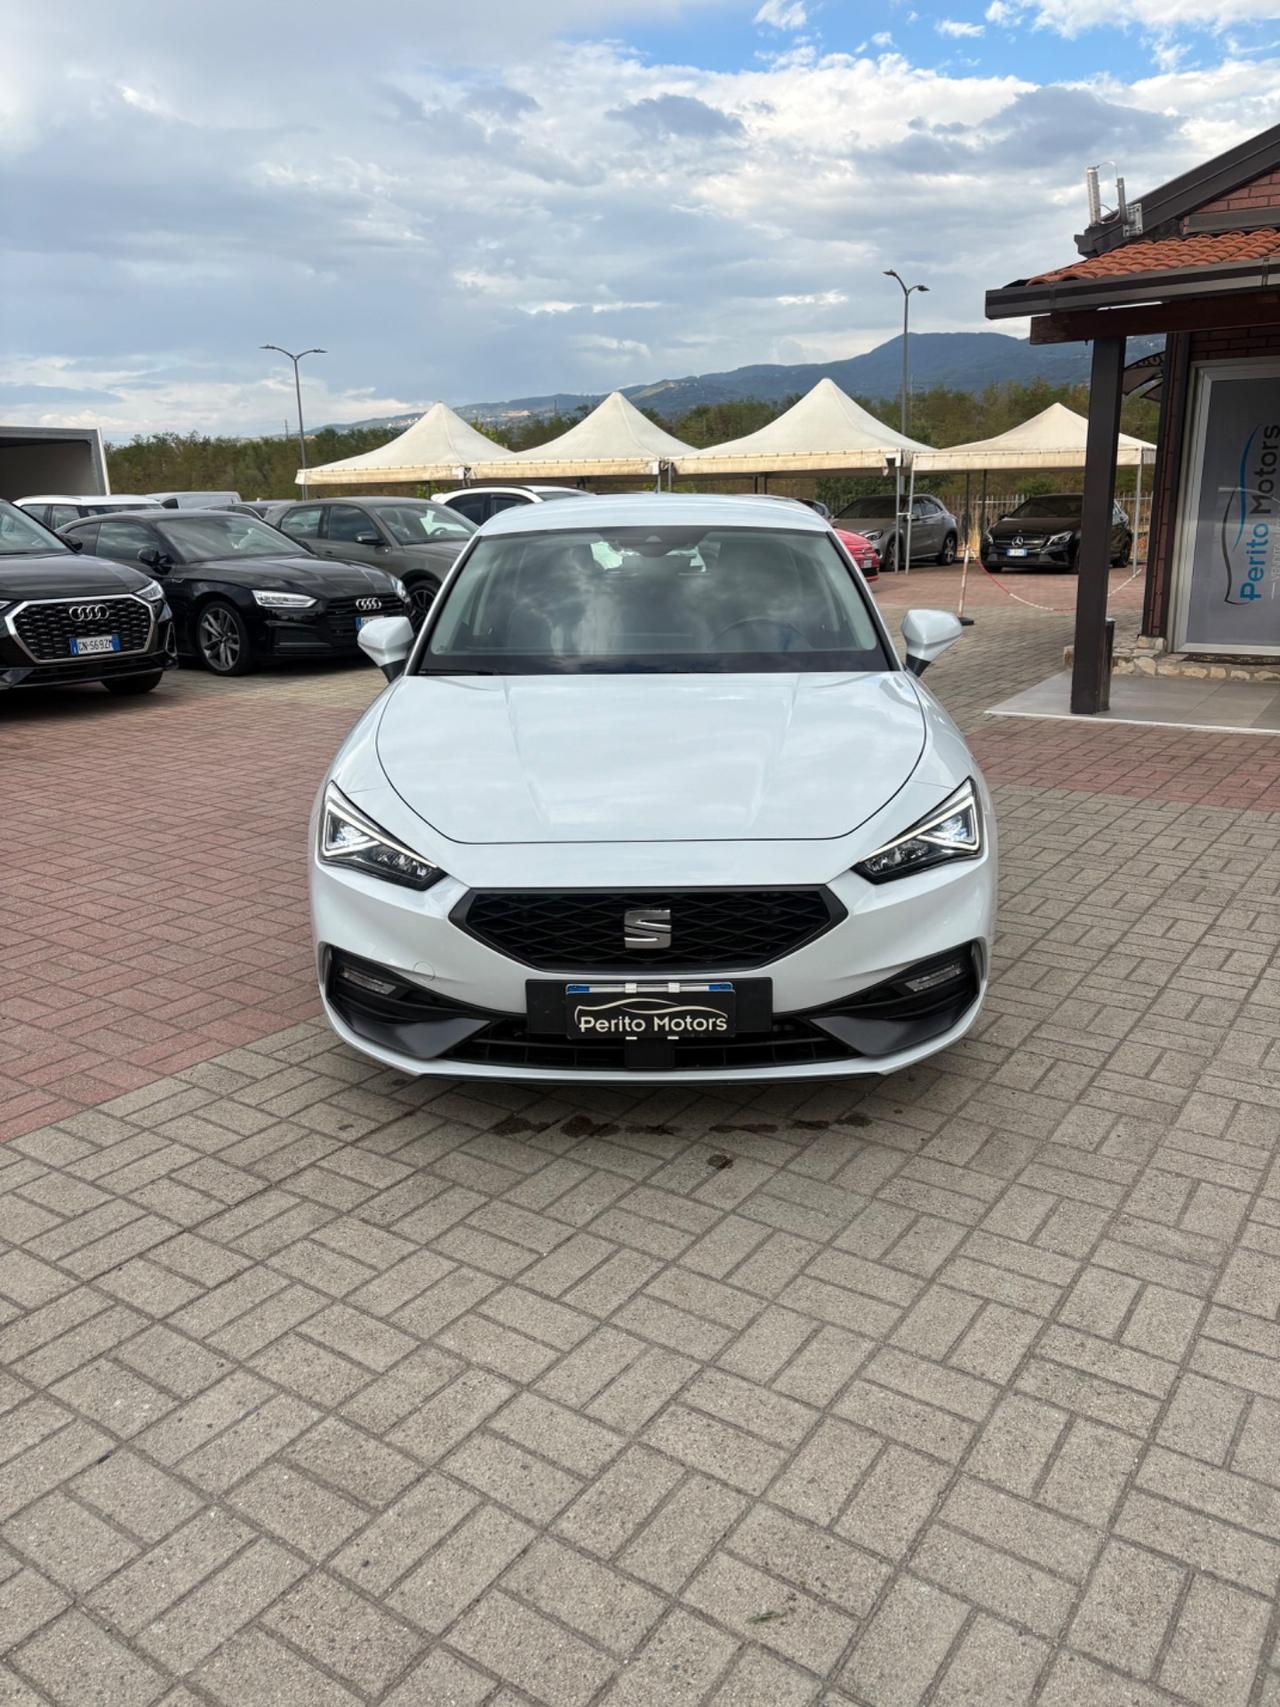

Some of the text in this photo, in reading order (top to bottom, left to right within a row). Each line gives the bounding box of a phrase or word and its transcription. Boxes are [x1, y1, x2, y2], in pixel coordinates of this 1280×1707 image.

[1240, 424, 1280, 600] Perito Motors
[579, 1014, 727, 1033] Perito Motors
